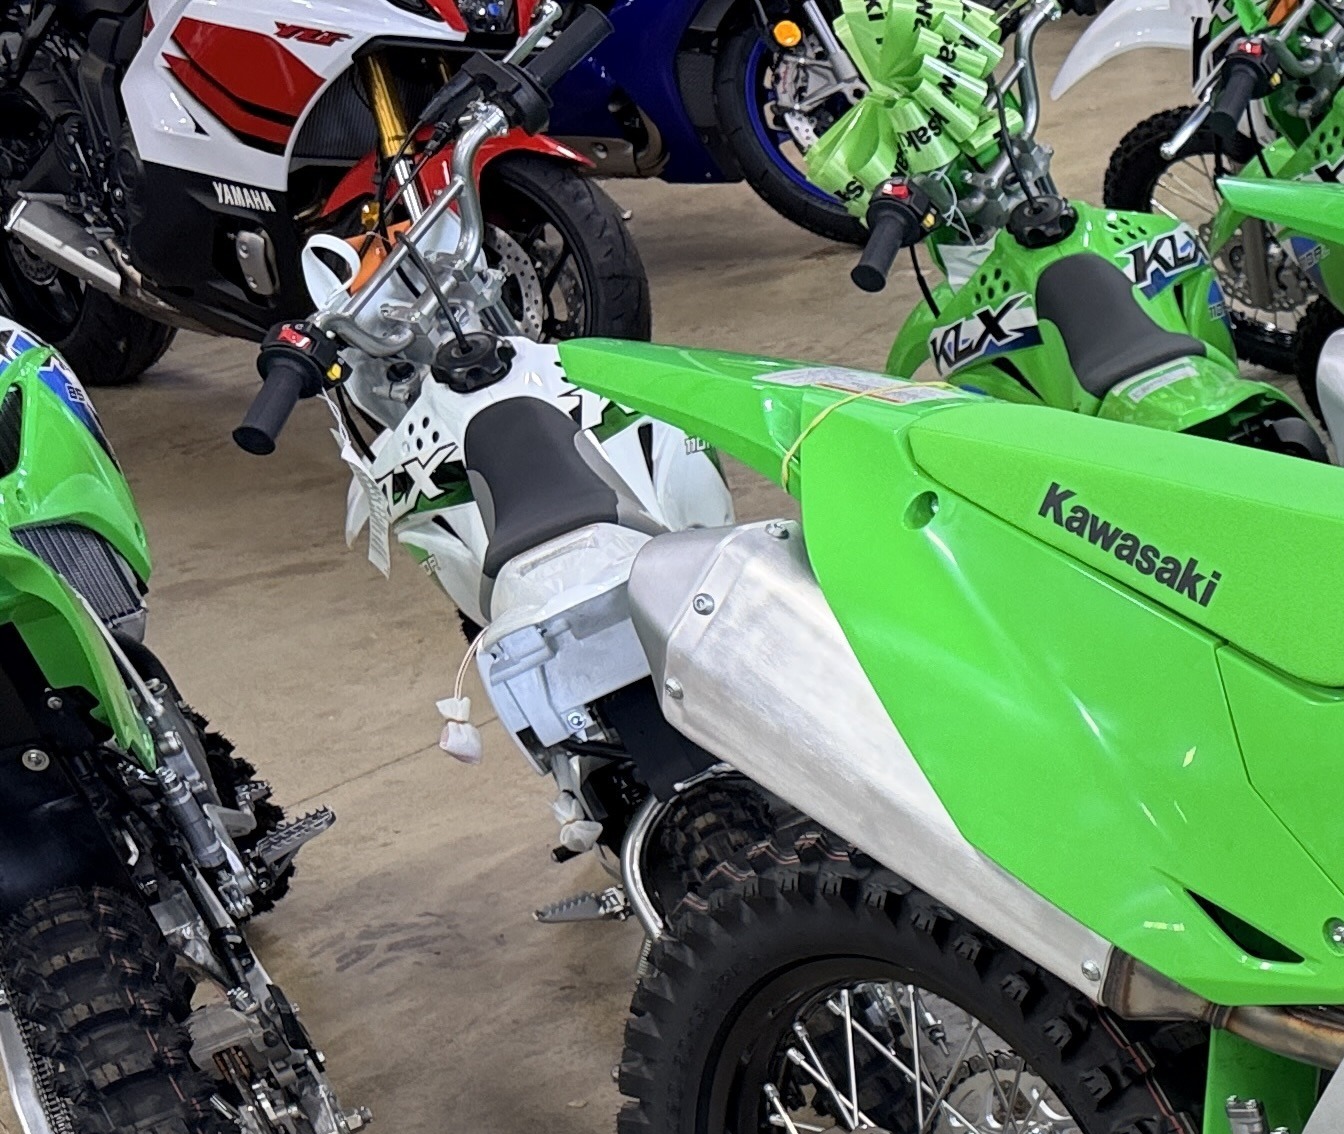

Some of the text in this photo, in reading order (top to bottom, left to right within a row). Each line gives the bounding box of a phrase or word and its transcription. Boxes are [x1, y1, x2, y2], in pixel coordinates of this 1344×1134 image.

[212, 181, 277, 212] YAMAHA
[931, 296, 1031, 376] KLX
[1038, 481, 1222, 607] Kawasaki
